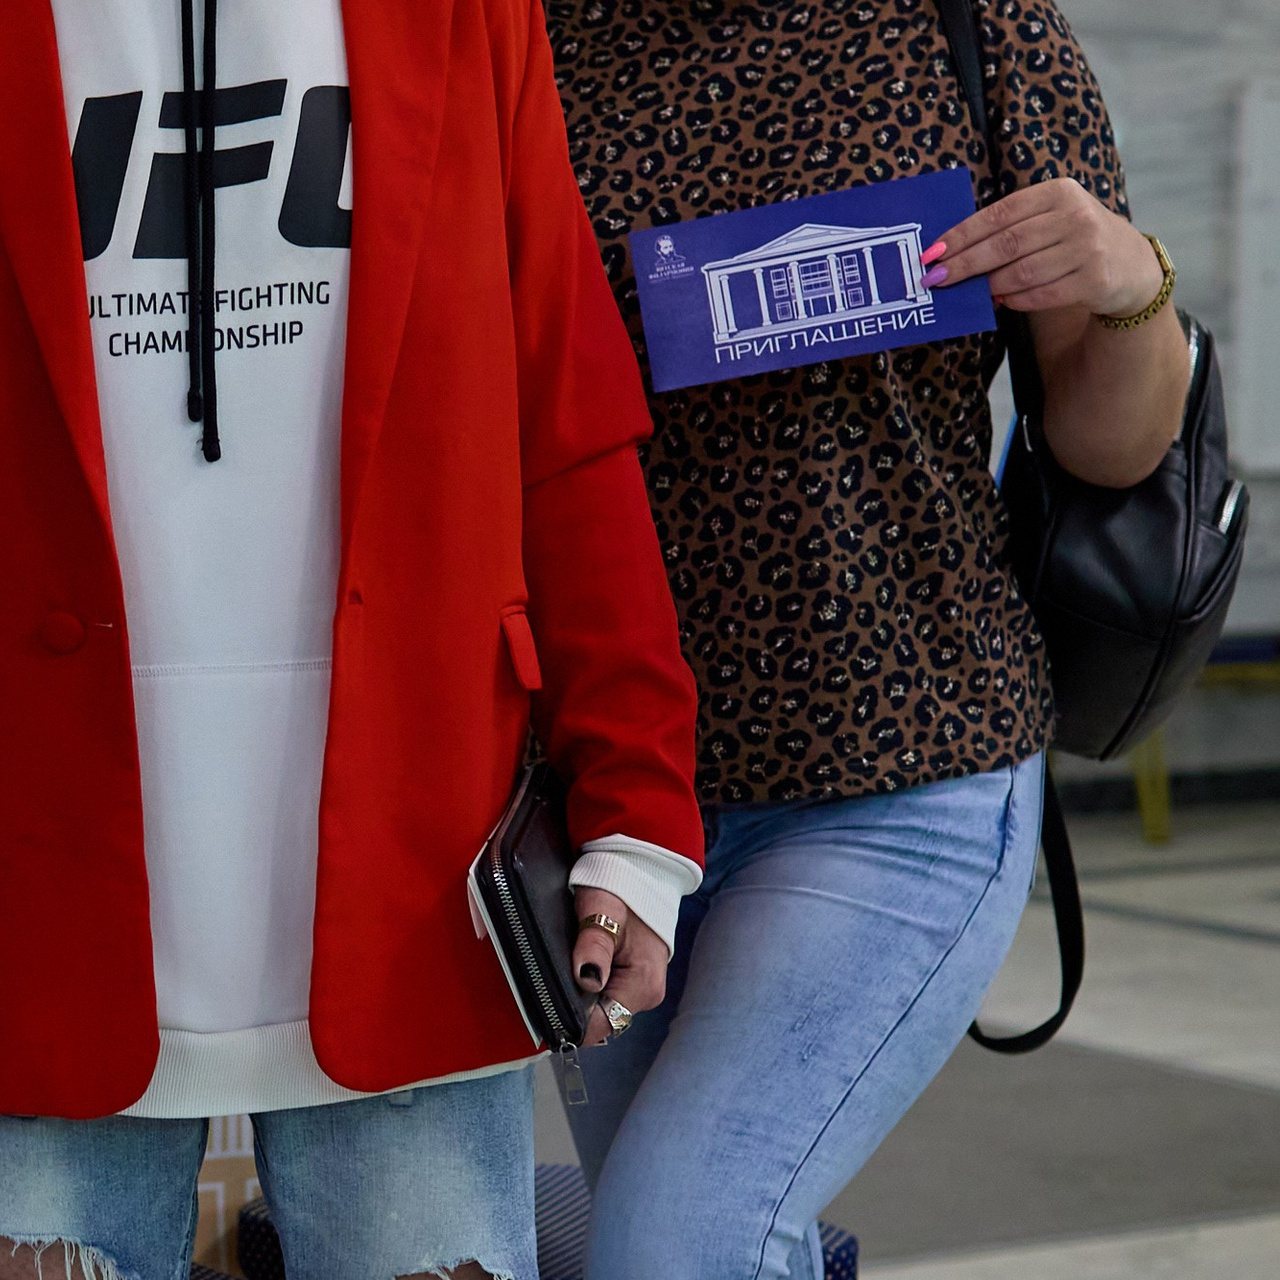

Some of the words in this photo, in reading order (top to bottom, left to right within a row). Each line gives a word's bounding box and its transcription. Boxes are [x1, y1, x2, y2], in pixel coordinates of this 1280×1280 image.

[89, 292, 191, 320] LTIMAT
[215, 281, 330, 313] FIGHTING
[109, 321, 303, 357] CHAMONSHIP
[714, 306, 937, 364] ПРИГЛАШЕНИЕ
